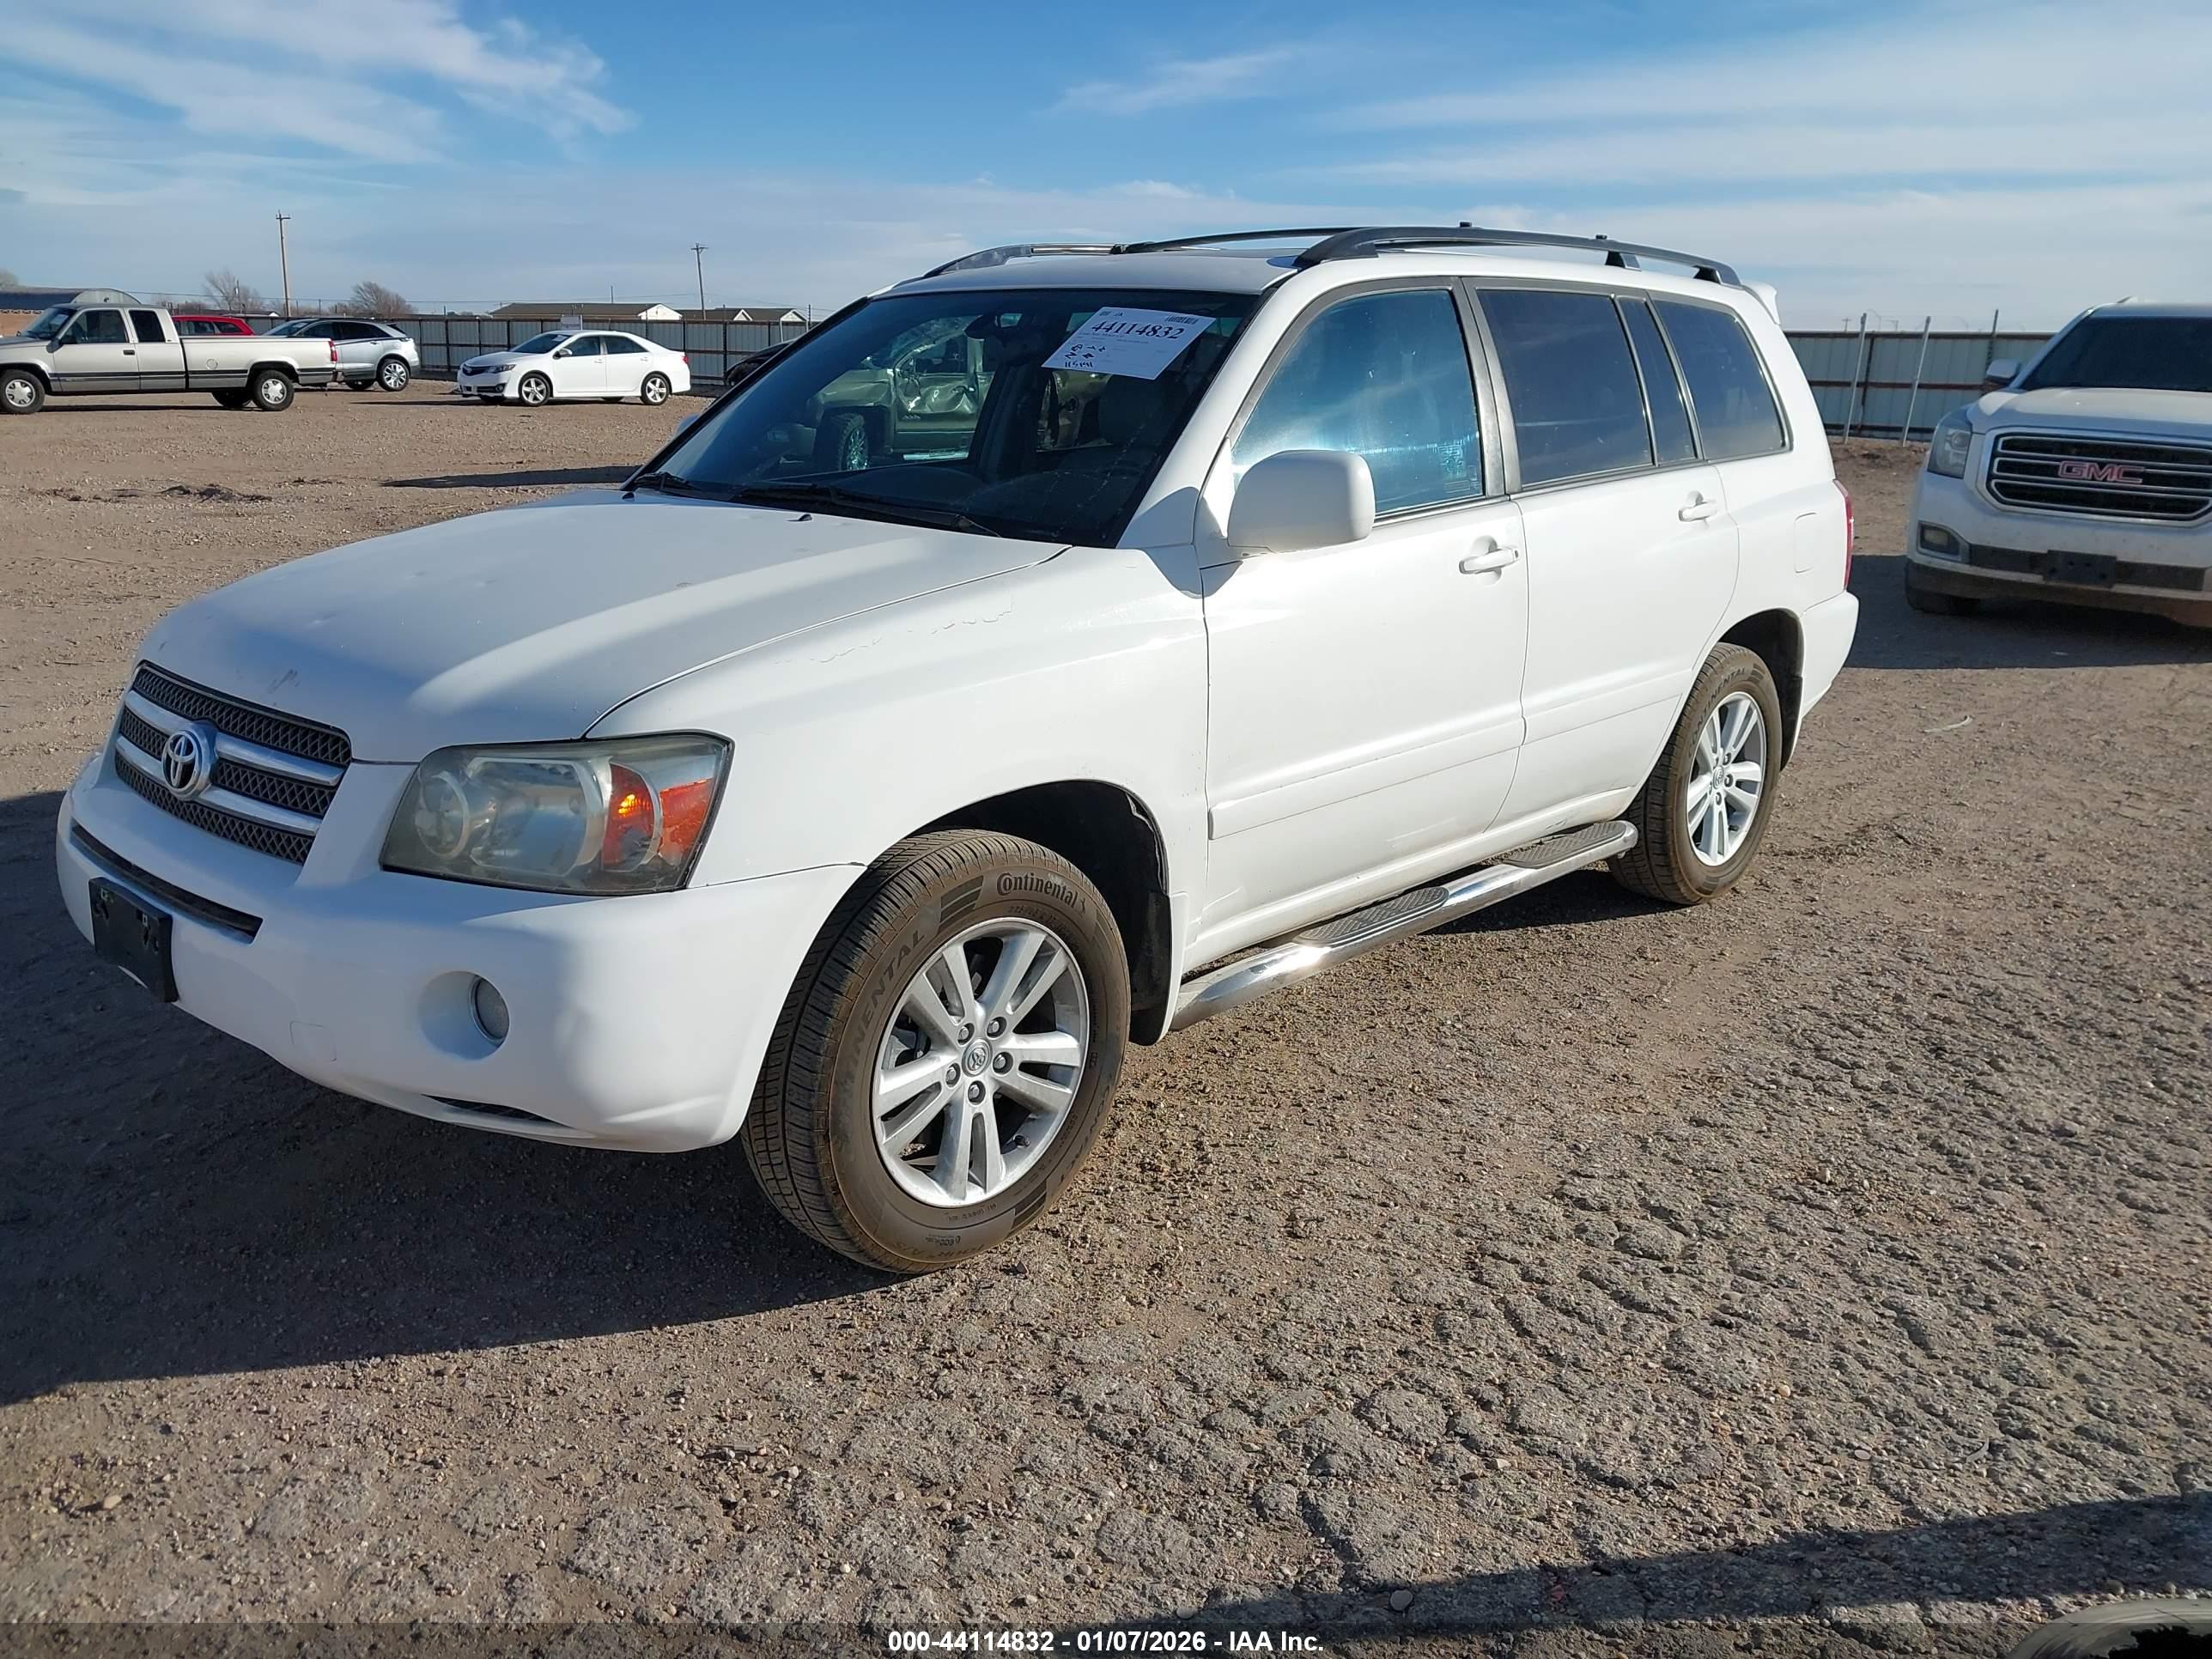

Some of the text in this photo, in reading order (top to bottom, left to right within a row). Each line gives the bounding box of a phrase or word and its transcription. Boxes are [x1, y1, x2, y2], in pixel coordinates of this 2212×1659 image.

[1091, 320, 1185, 339] 44114832
[2057, 460, 2144, 483] GMC
[996, 872, 1079, 908] Continental
